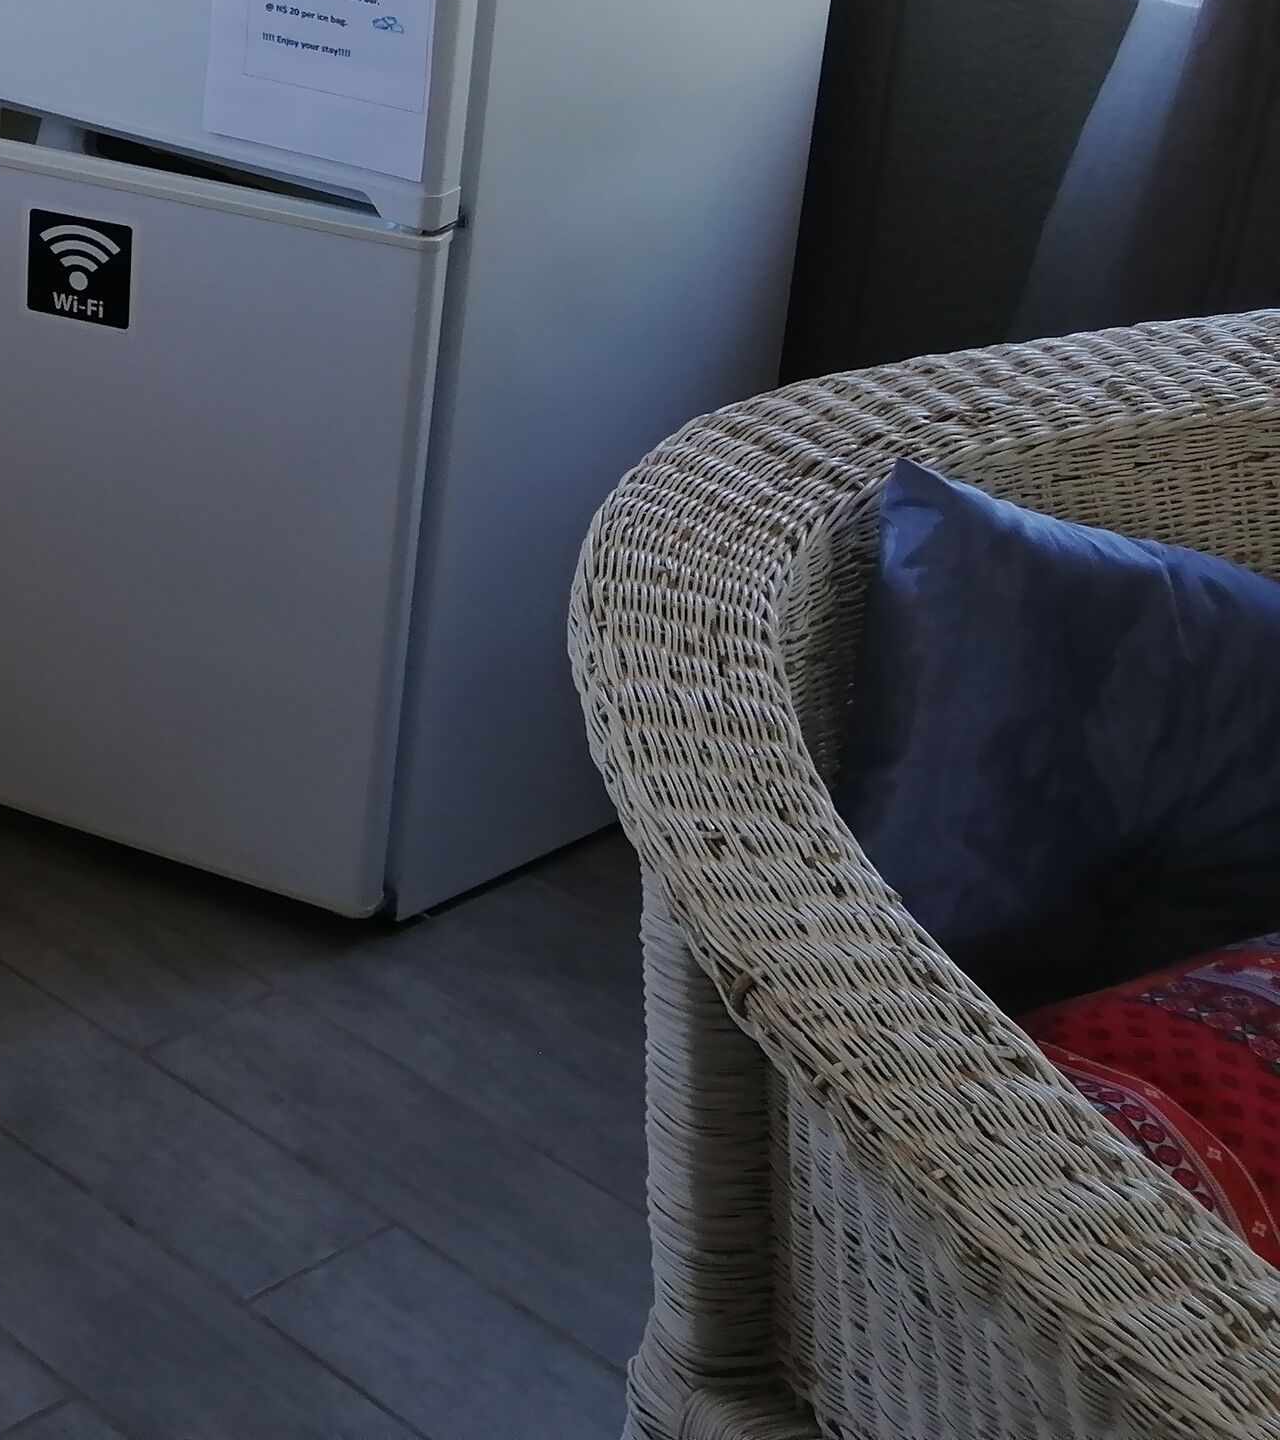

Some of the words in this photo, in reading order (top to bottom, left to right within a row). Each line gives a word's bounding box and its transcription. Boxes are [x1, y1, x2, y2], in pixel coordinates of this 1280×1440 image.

[265, 2, 274, 12] @
[276, 4, 287, 14] N$
[289, 7, 300, 16] 20
[301, 10, 315, 20] per
[317, 12, 329, 22] ice
[276, 35, 299, 48] Enjoy
[300, 40, 319, 51] your
[52, 291, 104, 318] Wi-Fi
